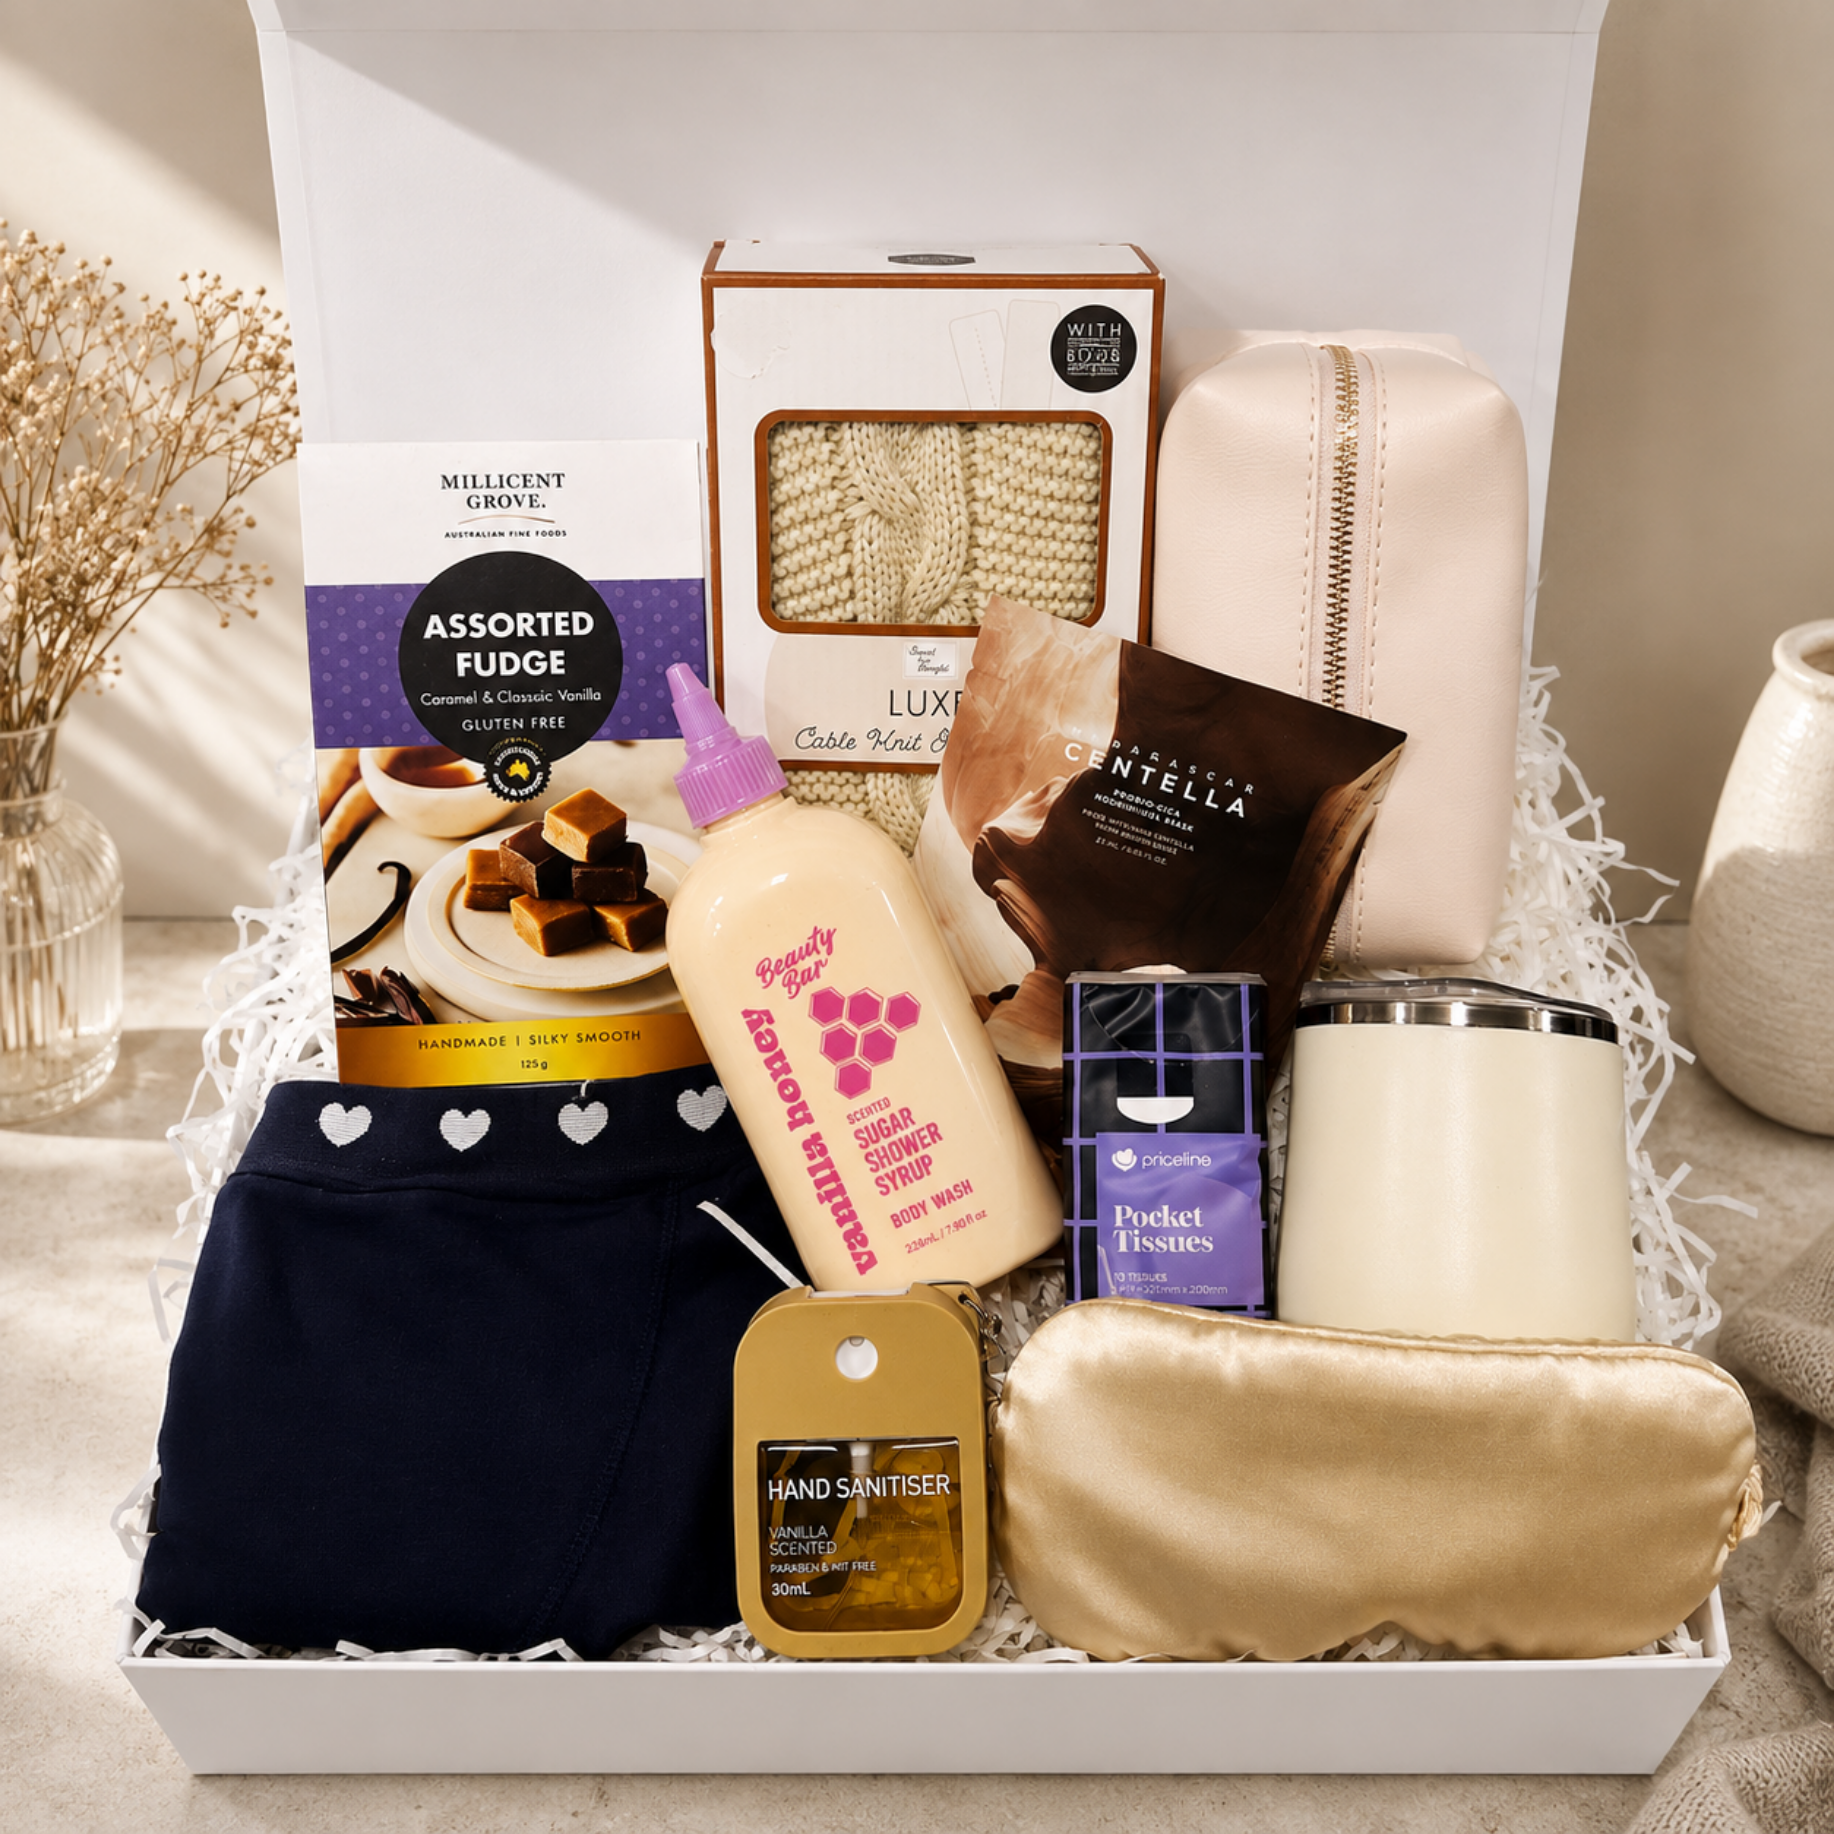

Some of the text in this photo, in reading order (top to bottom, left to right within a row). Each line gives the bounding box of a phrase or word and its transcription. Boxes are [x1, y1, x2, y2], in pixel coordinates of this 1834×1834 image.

[1066, 322, 1122, 337] WITH
[440, 472, 565, 490] MILLICENT
[466, 493, 547, 510] GROVE.
[444, 530, 567, 539] AUSTRALIAN FINE FOODS
[423, 611, 594, 640] ASSORTED
[456, 650, 565, 677] FUDGE
[420, 690, 478, 706] Caramel
[482, 691, 494, 704] &
[557, 687, 602, 702] Vanilla
[462, 716, 566, 732] GLUTEN FREE
[795, 726, 857, 750] Cable
[866, 727, 923, 752] Knit
[1064, 742, 1246, 818] CENTELLA
[755, 925, 837, 990] Beauty
[781, 957, 829, 1000] Bar
[418, 1034, 507, 1050] HANDMADE
[529, 1033, 569, 1046] SILKY
[575, 1030, 642, 1044] SMOOTH
[846, 1096, 891, 1125] SCENTED
[853, 1106, 916, 1150] SUGAR
[741, 1008, 879, 1276] vanilla honey
[864, 1121, 943, 1173] SHOWER
[1142, 1151, 1212, 1169] priceline
[874, 1153, 933, 1196] SYRUP
[889, 1178, 974, 1230] BODY WASH
[1113, 1204, 1205, 1228] Pocket
[1112, 1229, 1215, 1254] Tissues
[768, 1474, 951, 1501] HAND SANITISER
[768, 1525, 829, 1540] VANILLA
[769, 1540, 838, 1556] SCENTED
[852, 1560, 877, 1572] FREE
[771, 1581, 812, 1597] 30mL
